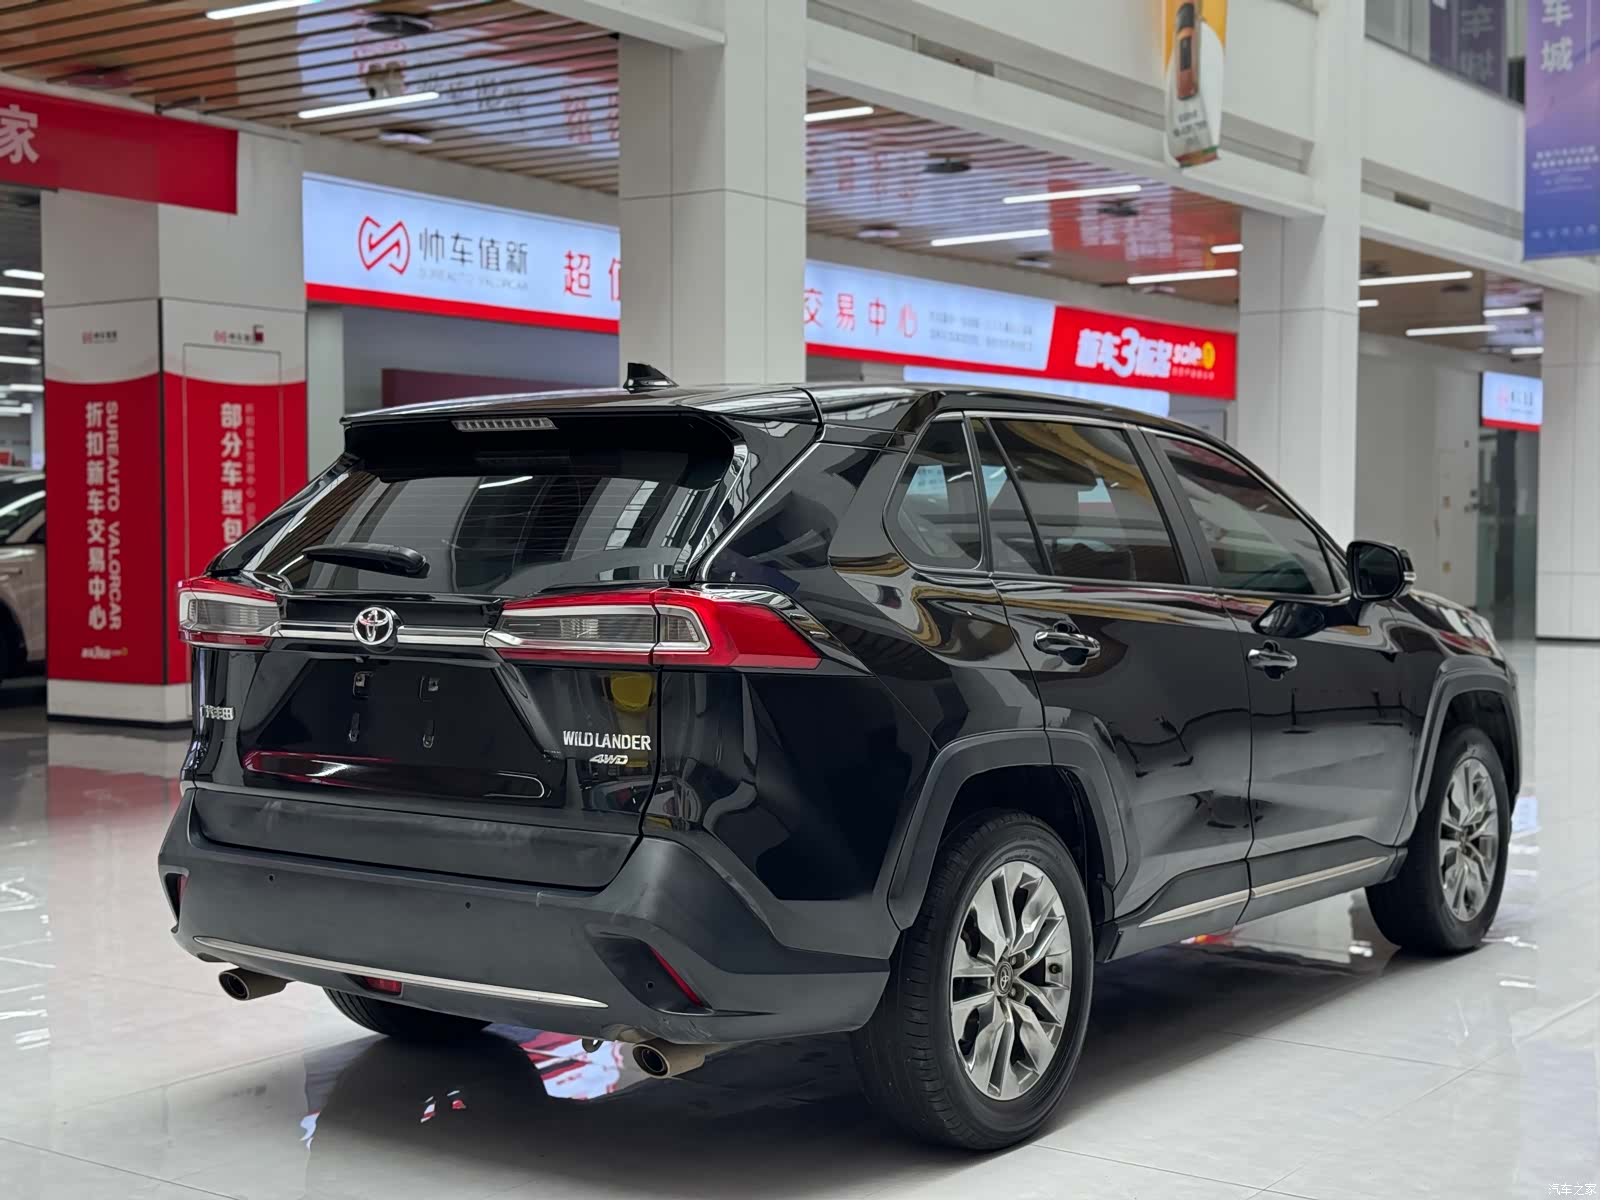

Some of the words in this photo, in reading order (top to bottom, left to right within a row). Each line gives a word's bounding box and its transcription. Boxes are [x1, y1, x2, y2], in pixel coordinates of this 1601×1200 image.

[1541, 0, 1574, 73] 车城
[418, 227, 529, 276] 帅车值新
[804, 288, 918, 339] 交易中心
[106, 401, 120, 511] SUREAUTO
[85, 402, 107, 630] 折扣新车交易中心
[108, 521, 122, 630] VALORCAR
[589, 753, 629, 765] 4WD
